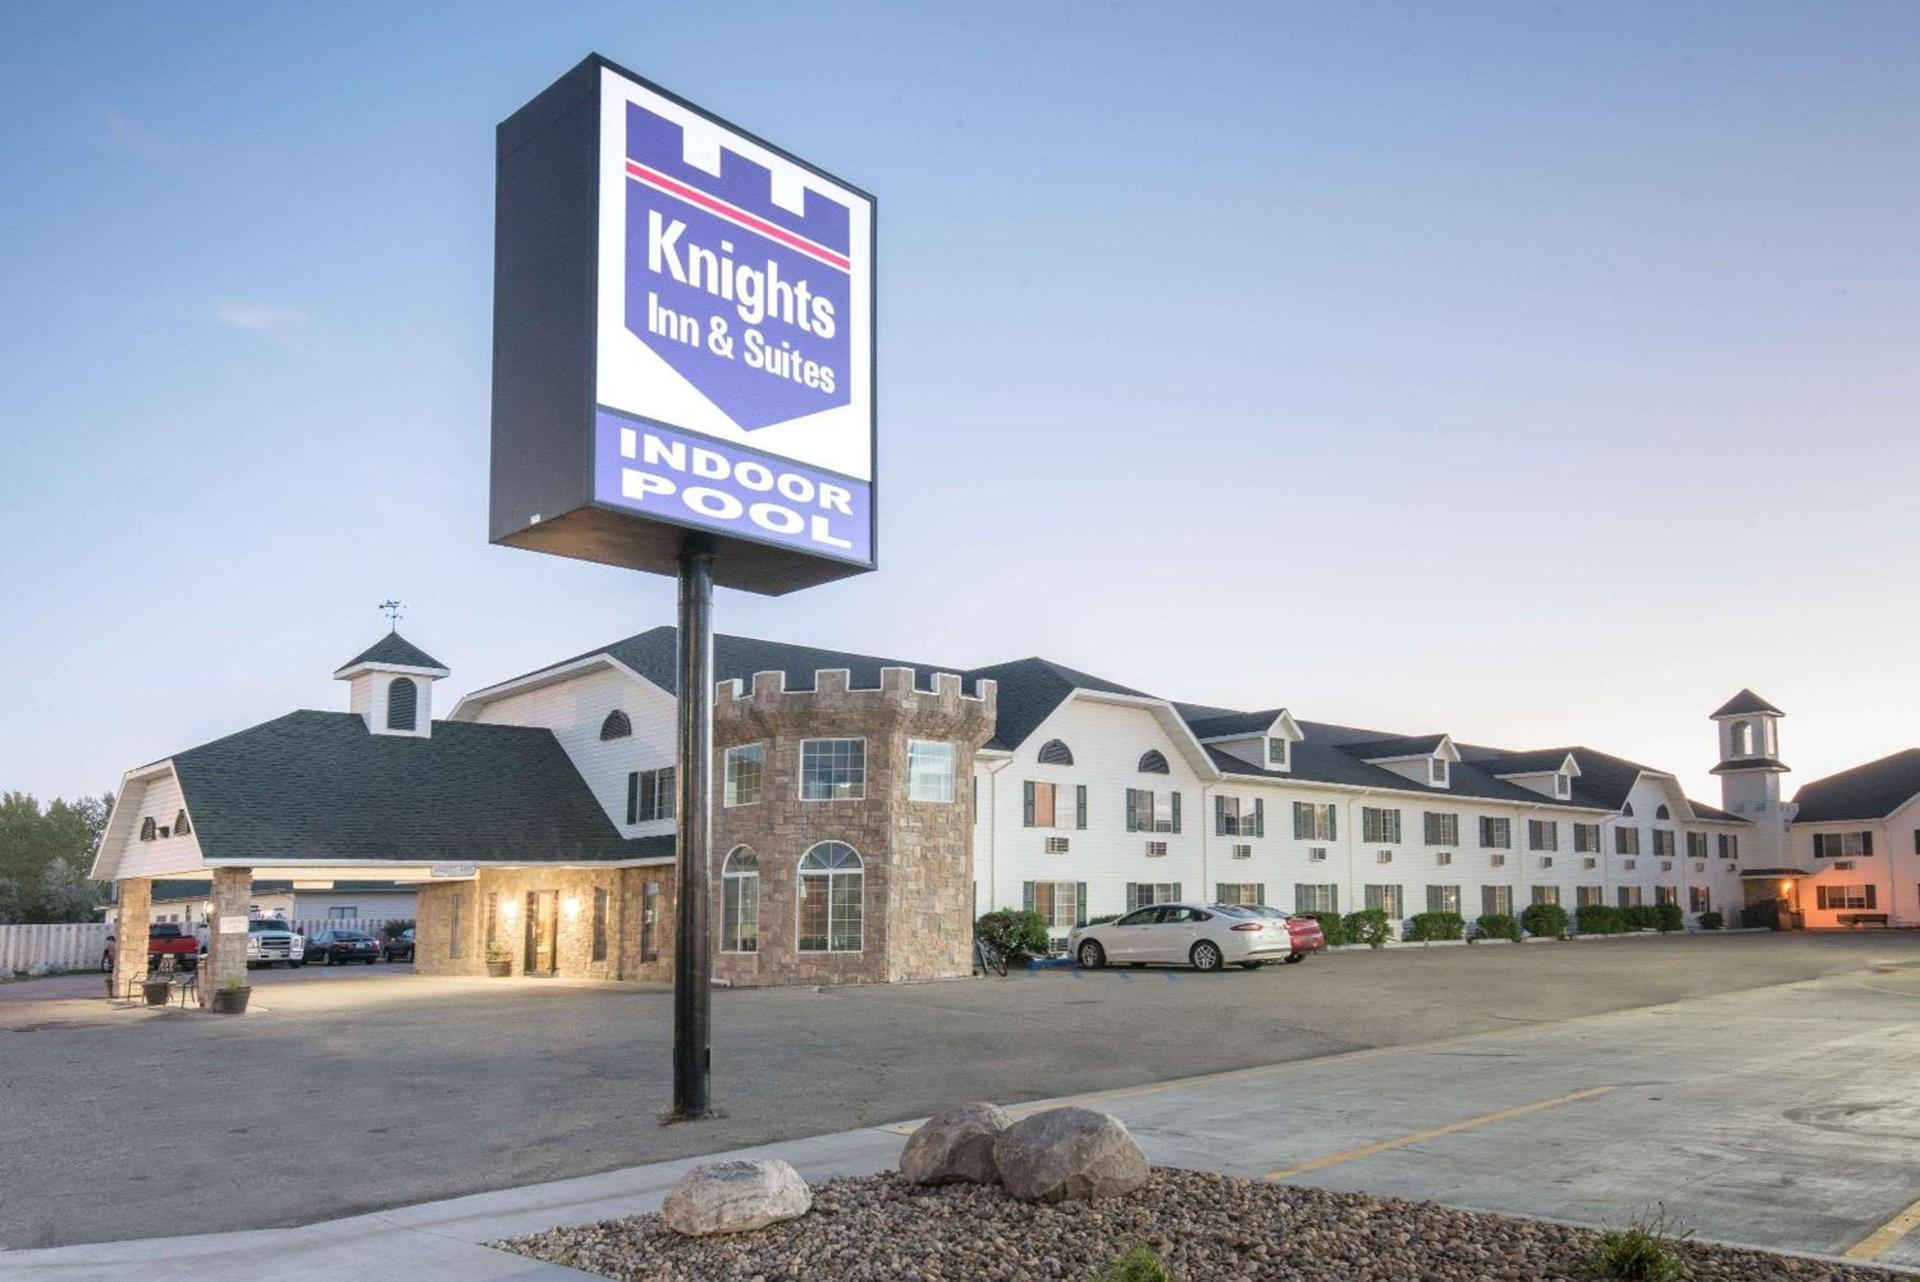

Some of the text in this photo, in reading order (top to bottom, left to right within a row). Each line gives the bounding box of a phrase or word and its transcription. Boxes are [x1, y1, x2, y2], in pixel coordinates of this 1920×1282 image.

[648, 209, 836, 339] Knights
[648, 291, 836, 394] Inn & Suites
[619, 427, 854, 516] INDOOR
[620, 467, 853, 550] POOL
